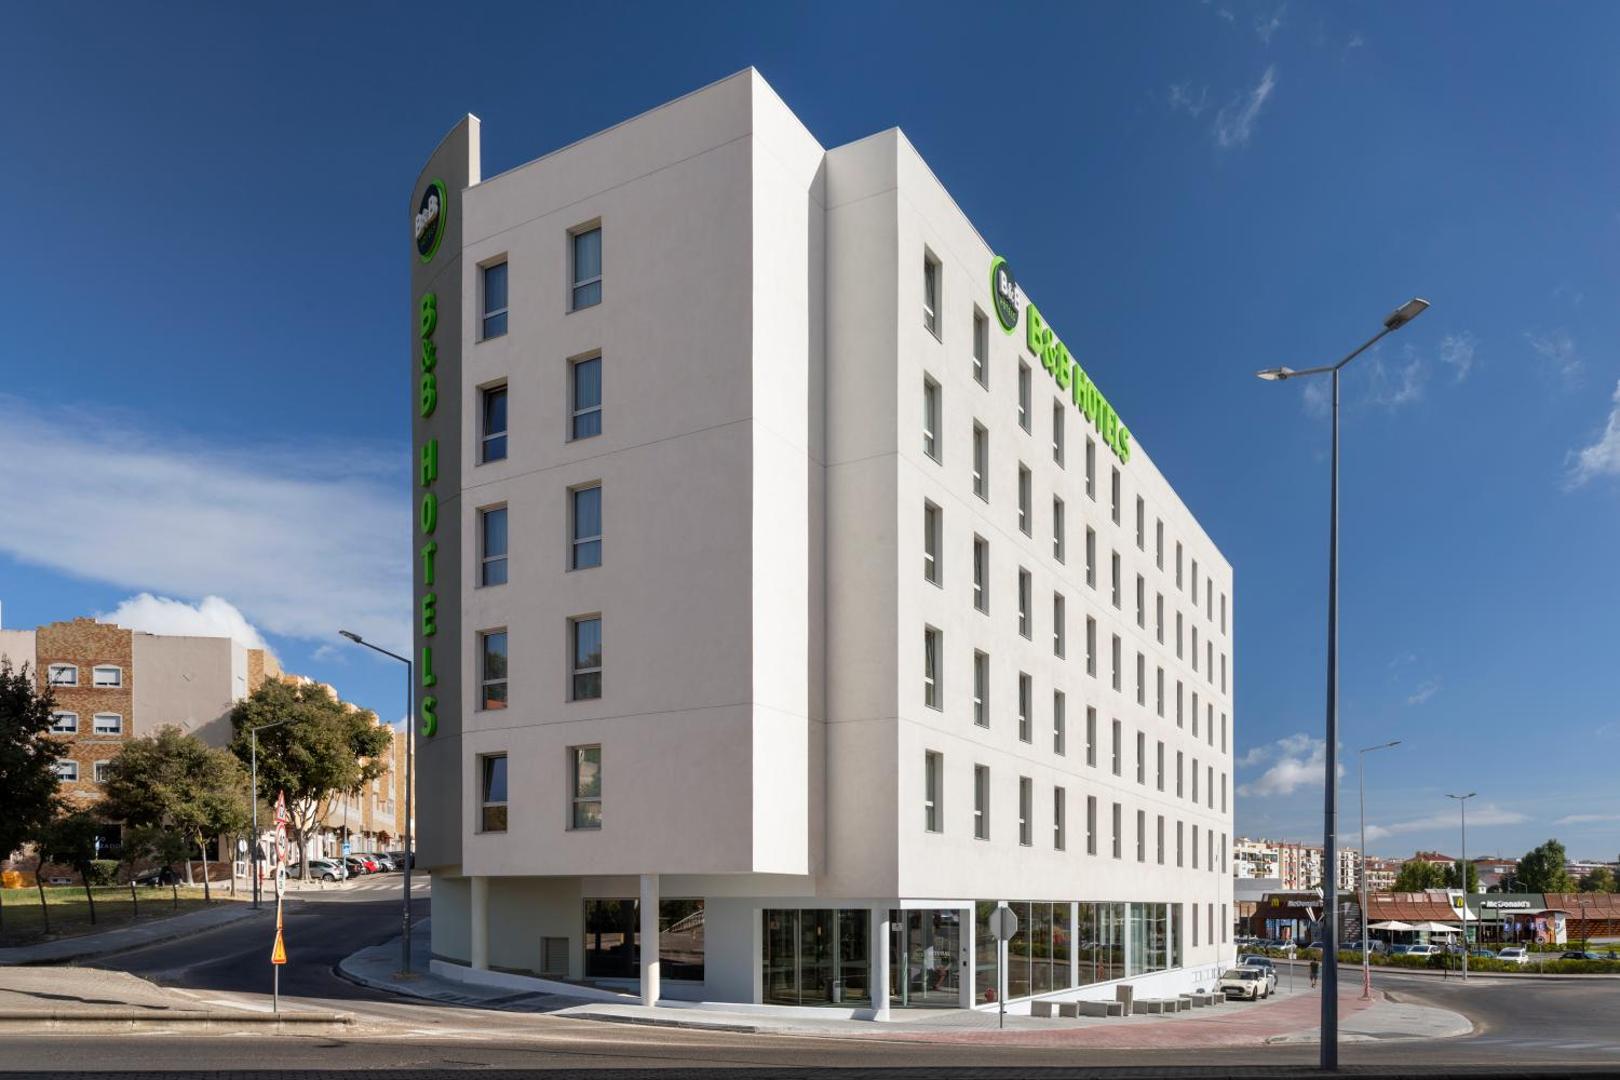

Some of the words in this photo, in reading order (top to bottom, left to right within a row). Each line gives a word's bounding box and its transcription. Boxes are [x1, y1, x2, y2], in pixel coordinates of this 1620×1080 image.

[415, 194, 438, 238] B&B
[999, 270, 1020, 312] B&B
[420, 292, 437, 418] B&B
[1026, 304, 1070, 391] B&B
[1072, 365, 1130, 464] HOTELS
[420, 437, 438, 737] HOTELS
[1487, 900, 1530, 908] McDonald's
